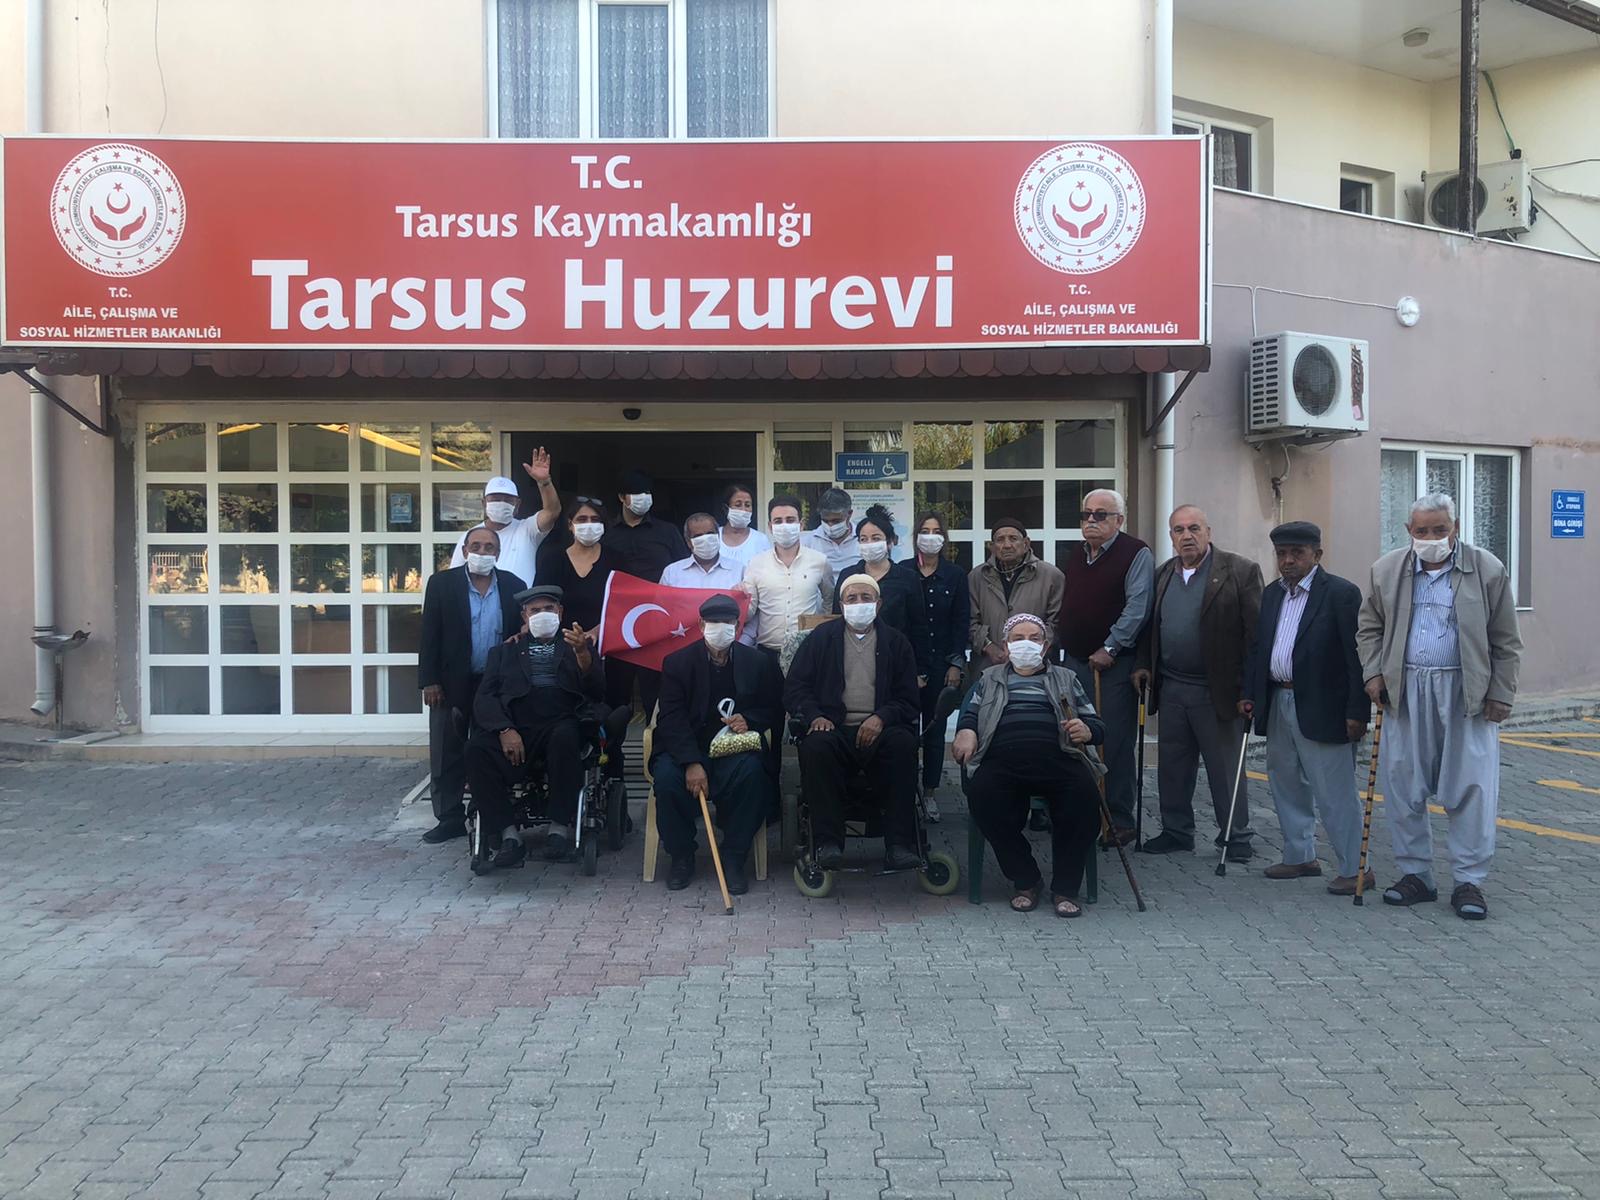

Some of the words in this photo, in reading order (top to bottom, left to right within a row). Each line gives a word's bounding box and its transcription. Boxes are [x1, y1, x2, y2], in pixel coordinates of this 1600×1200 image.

[571, 155, 643, 190] T.C.
[395, 205, 518, 238] Tarsus
[533, 203, 812, 248] Kaymakamlığı
[108, 287, 132, 298] T.C.
[251, 259, 527, 331] Tarsus
[564, 255, 954, 331] Huzurevi
[1068, 284, 1091, 295] T.C.
[63, 305, 96, 319] AİLE,
[99, 307, 157, 320] ÇALIŞMA
[161, 307, 178, 318] VE
[1023, 302, 1056, 317] AİLE,
[1059, 304, 1116, 317] ÇALIŞMA
[1119, 303, 1136, 315] VE
[19, 327, 70, 338] SOSYAL
[73, 325, 148, 338] HİZMETLER
[151, 326, 221, 339] BAKANLIĞI
[981, 324, 1030, 336] SOSYAL
[1033, 322, 1106, 335] HİZMETLER
[1109, 321, 1179, 334] BAKANLIĞI
[847, 458, 874, 467] ENGELLİ
[846, 468, 875, 476] RAMPASI
